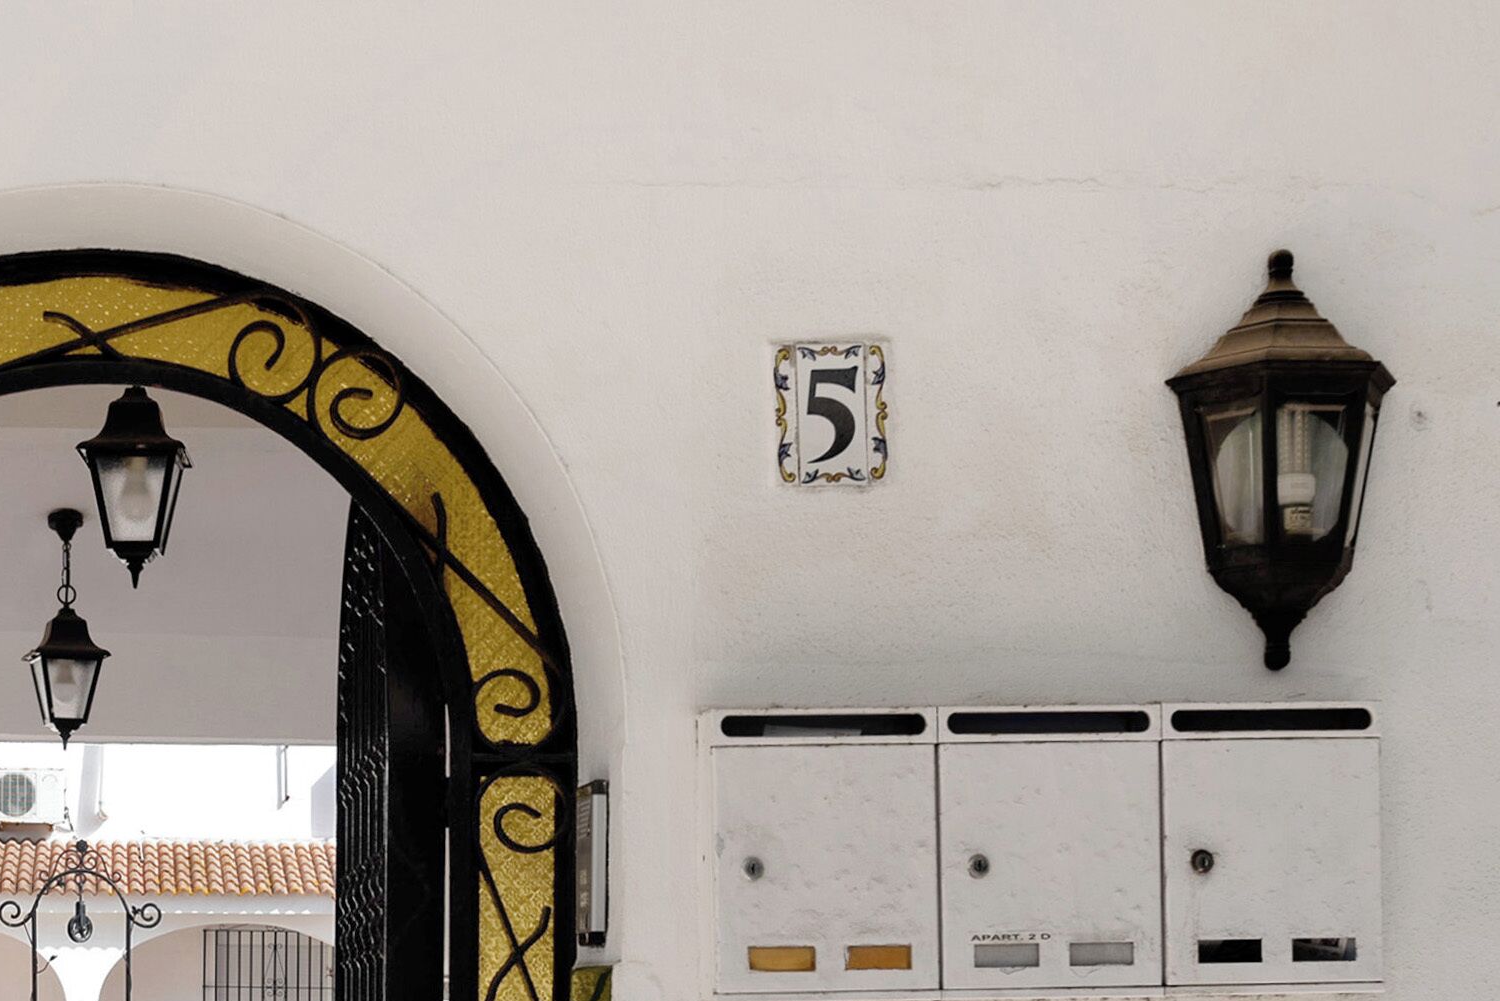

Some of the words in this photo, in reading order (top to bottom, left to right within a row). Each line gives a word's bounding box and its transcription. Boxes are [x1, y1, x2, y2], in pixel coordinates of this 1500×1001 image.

[806, 365, 859, 464] 5
[971, 933, 1024, 942] APART.
[1028, 932, 1037, 941] 2
[1040, 932, 1052, 941] D
